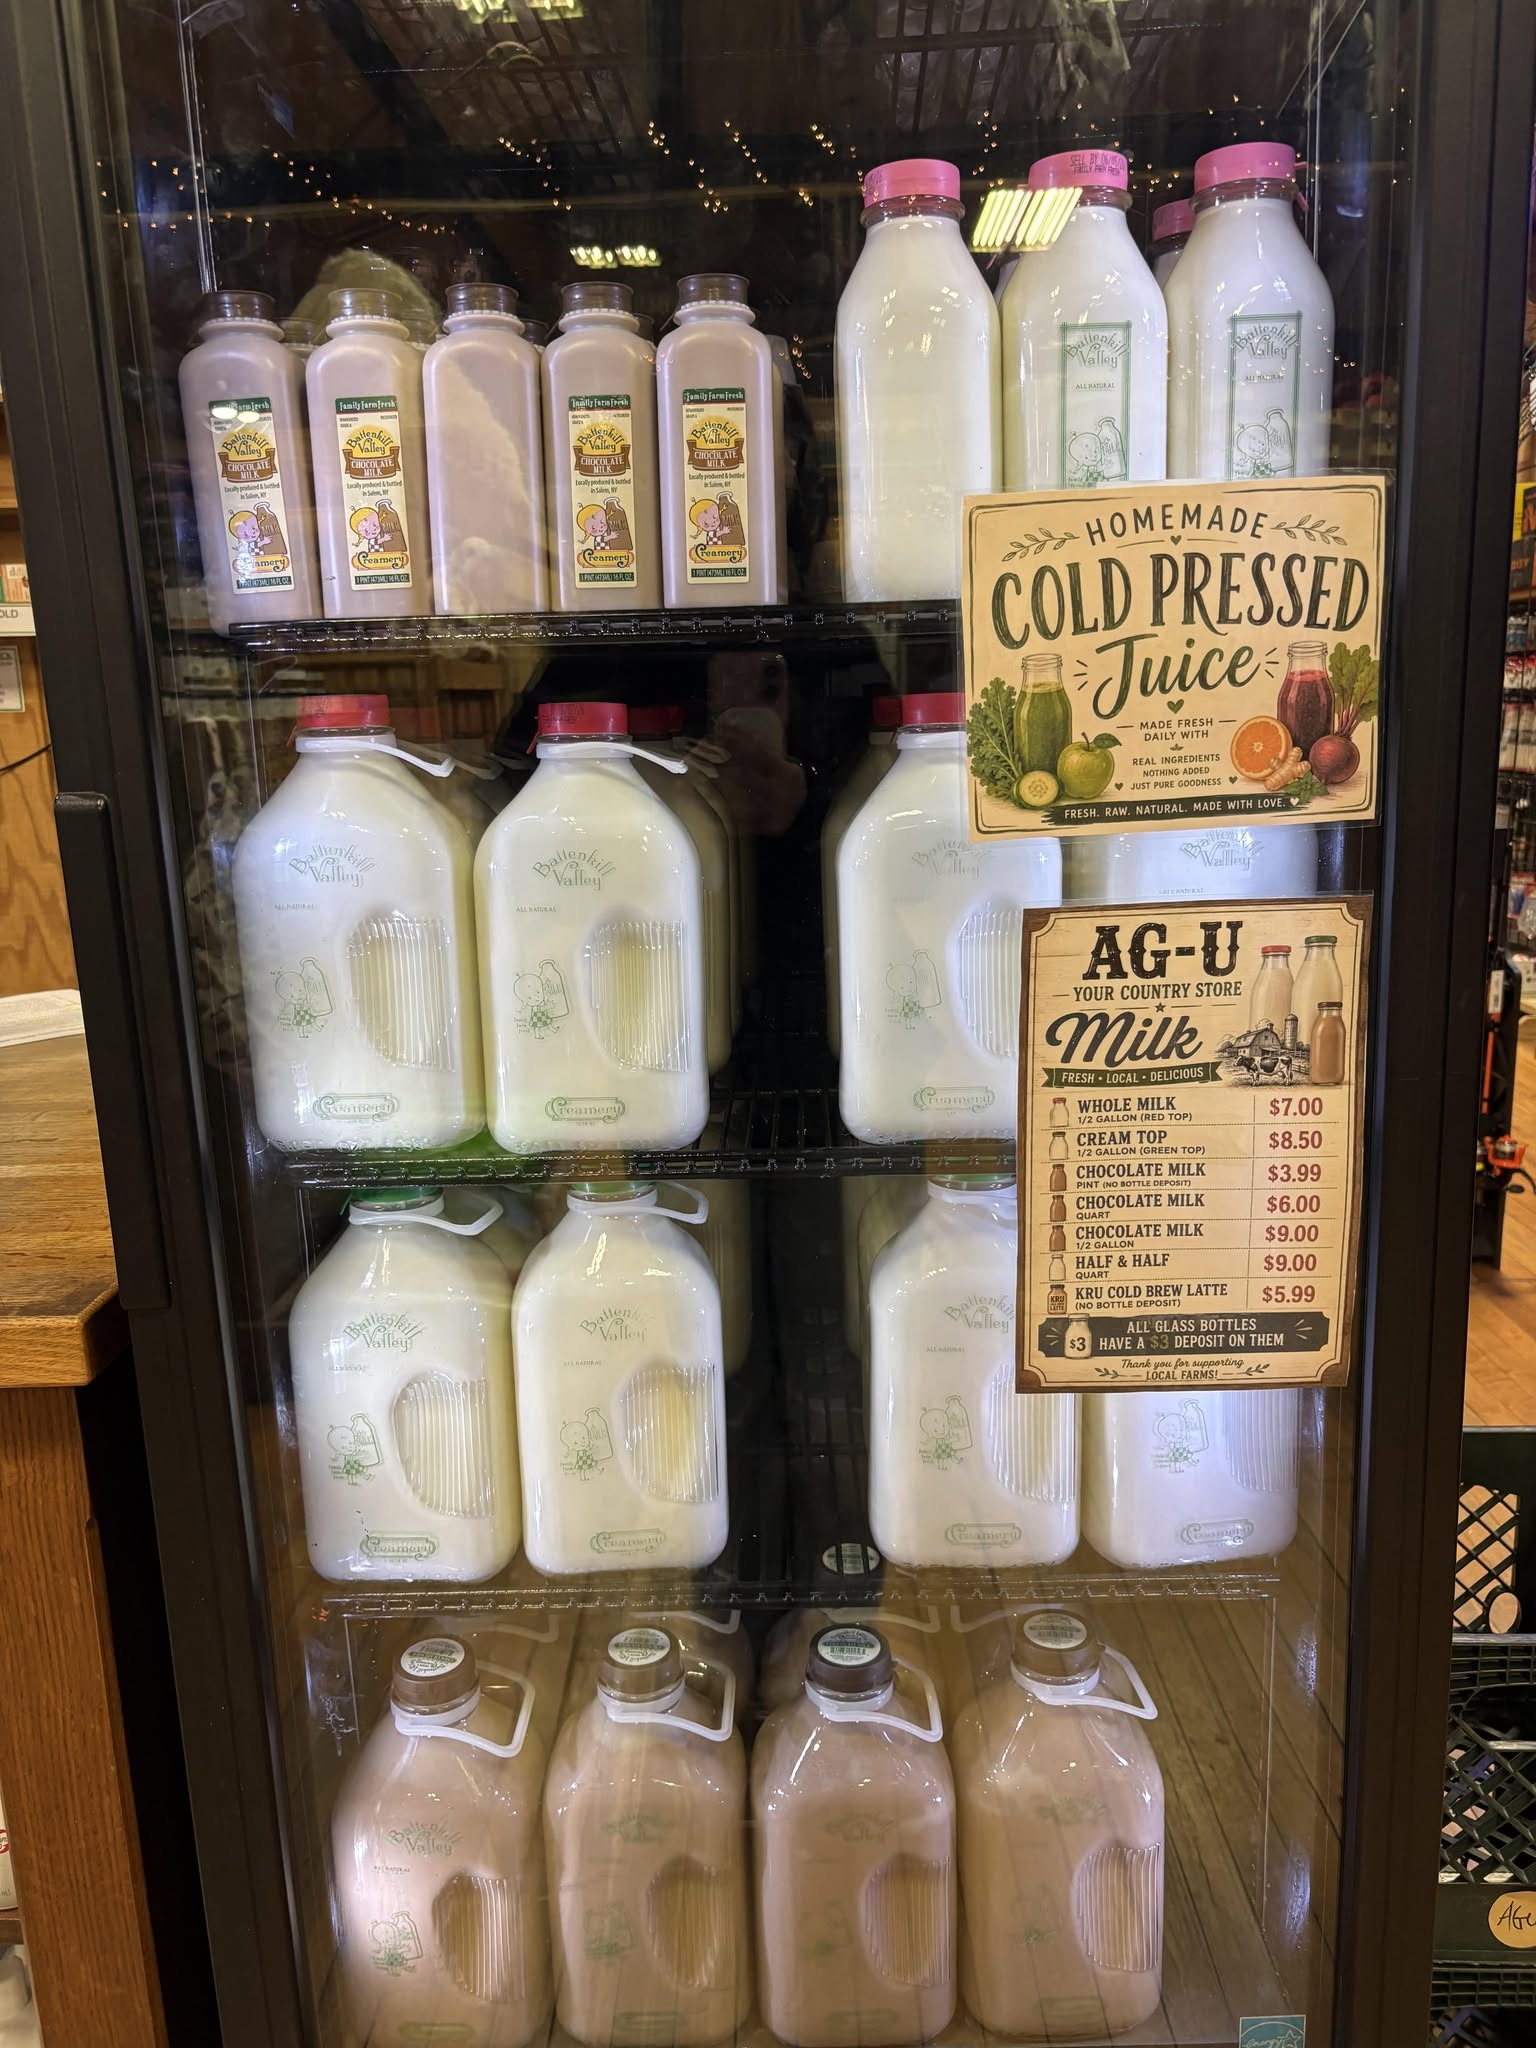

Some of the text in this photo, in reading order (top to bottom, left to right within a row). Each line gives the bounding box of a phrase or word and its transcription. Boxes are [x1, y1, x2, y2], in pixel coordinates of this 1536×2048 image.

[1064, 332, 1129, 358] Battenkill
[1250, 334, 1287, 360] Valley
[1080, 343, 1118, 369] Valley
[578, 426, 624, 447] Battenkill
[691, 420, 739, 440] Battenkill
[702, 428, 730, 446] Valley
[222, 432, 270, 452] Battenkill
[346, 430, 394, 449] Battenkill
[358, 437, 386, 455] Valley
[588, 435, 616, 453] Valley
[234, 440, 262, 458] Valley
[694, 450, 738, 460] CHOCOLATE
[227, 461, 270, 472] CHOCOLATE
[351, 459, 394, 469] CHOCOLATE
[581, 456, 624, 466] CHOCOLATE
[593, 465, 612, 474] MILK
[707, 459, 726, 468] MILK
[240, 470, 260, 479] MILK
[364, 468, 384, 476] MILK
[1085, 503, 1269, 546] HOMEMADE
[358, 551, 404, 569] Creamery
[582, 548, 630, 568] Creamery
[695, 543, 743, 563] Creamery
[991, 551, 1370, 650] COLD PRESSED
[1092, 633, 1261, 720] Juice
[1139, 717, 1214, 731] MADE FRESH
[1144, 729, 1210, 742] DAILY WITH
[1132, 754, 1221, 767] REAL INGREDIENTS
[1142, 766, 1210, 778] NOTHING ADDED
[1130, 777, 1222, 791] JUST PURE GOODNESS
[1064, 797, 1286, 820] FRESH. RAW. NATURAL. MADE WITH LOVE.
[532, 848, 617, 879] Battenkill
[1201, 841, 1251, 871] Valley
[552, 860, 601, 891] Valley
[1082, 920, 1243, 981] AG-U
[1073, 981, 1243, 1002] YOUR COUNTRY STORE
[1045, 1011, 1203, 1068] Milk
[1061, 1067, 1204, 1084] FRESH LOCAL DELICIOUS
[550, 1096, 624, 1124] Creamery
[1077, 1096, 1323, 1118] WHOLE MILK $7.00
[1077, 1112, 1193, 1125] 1/2 GALLON (RED TOP)
[1076, 1129, 1323, 1151] CREAM TOP $8.50
[1077, 1145, 1206, 1157] 1/2 GALLON (GREEN TOP)
[1076, 1162, 1322, 1184] CHOCOLATE MILK $3.99
[1076, 1178, 1191, 1189] PINT (NO BOTTLE DEPOSIT)
[1076, 1193, 1321, 1215] CHOCOLATE MILK $6.00
[1076, 1211, 1111, 1220] QUART
[1076, 1223, 1319, 1244] CHOCOLATE MILK $9.00
[1076, 1240, 1135, 1250] 1/2 GALLON
[1075, 1253, 1318, 1273] HALF & HALF $9.00
[1075, 1271, 1110, 1280] QUART
[1050, 1295, 1065, 1303] KRU
[1075, 1283, 1316, 1305] KRU COLD BREW LATTE $5.99
[1075, 1299, 1181, 1311] (NO BOTTLE DEPOSIT)
[963, 1307, 1009, 1334] Valley
[1127, 1318, 1257, 1334] ALL GLASS BOTTLES
[362, 1325, 409, 1352] Valley
[1069, 1337, 1087, 1352] $3
[1099, 1333, 1285, 1351] HAVE A $3 DEPOSIT ON THEM
[1121, 1356, 1245, 1372] Thank you for supporting
[1145, 1368, 1219, 1381] LOCAL FARMS!
[405, 1830, 453, 1856] Valley
